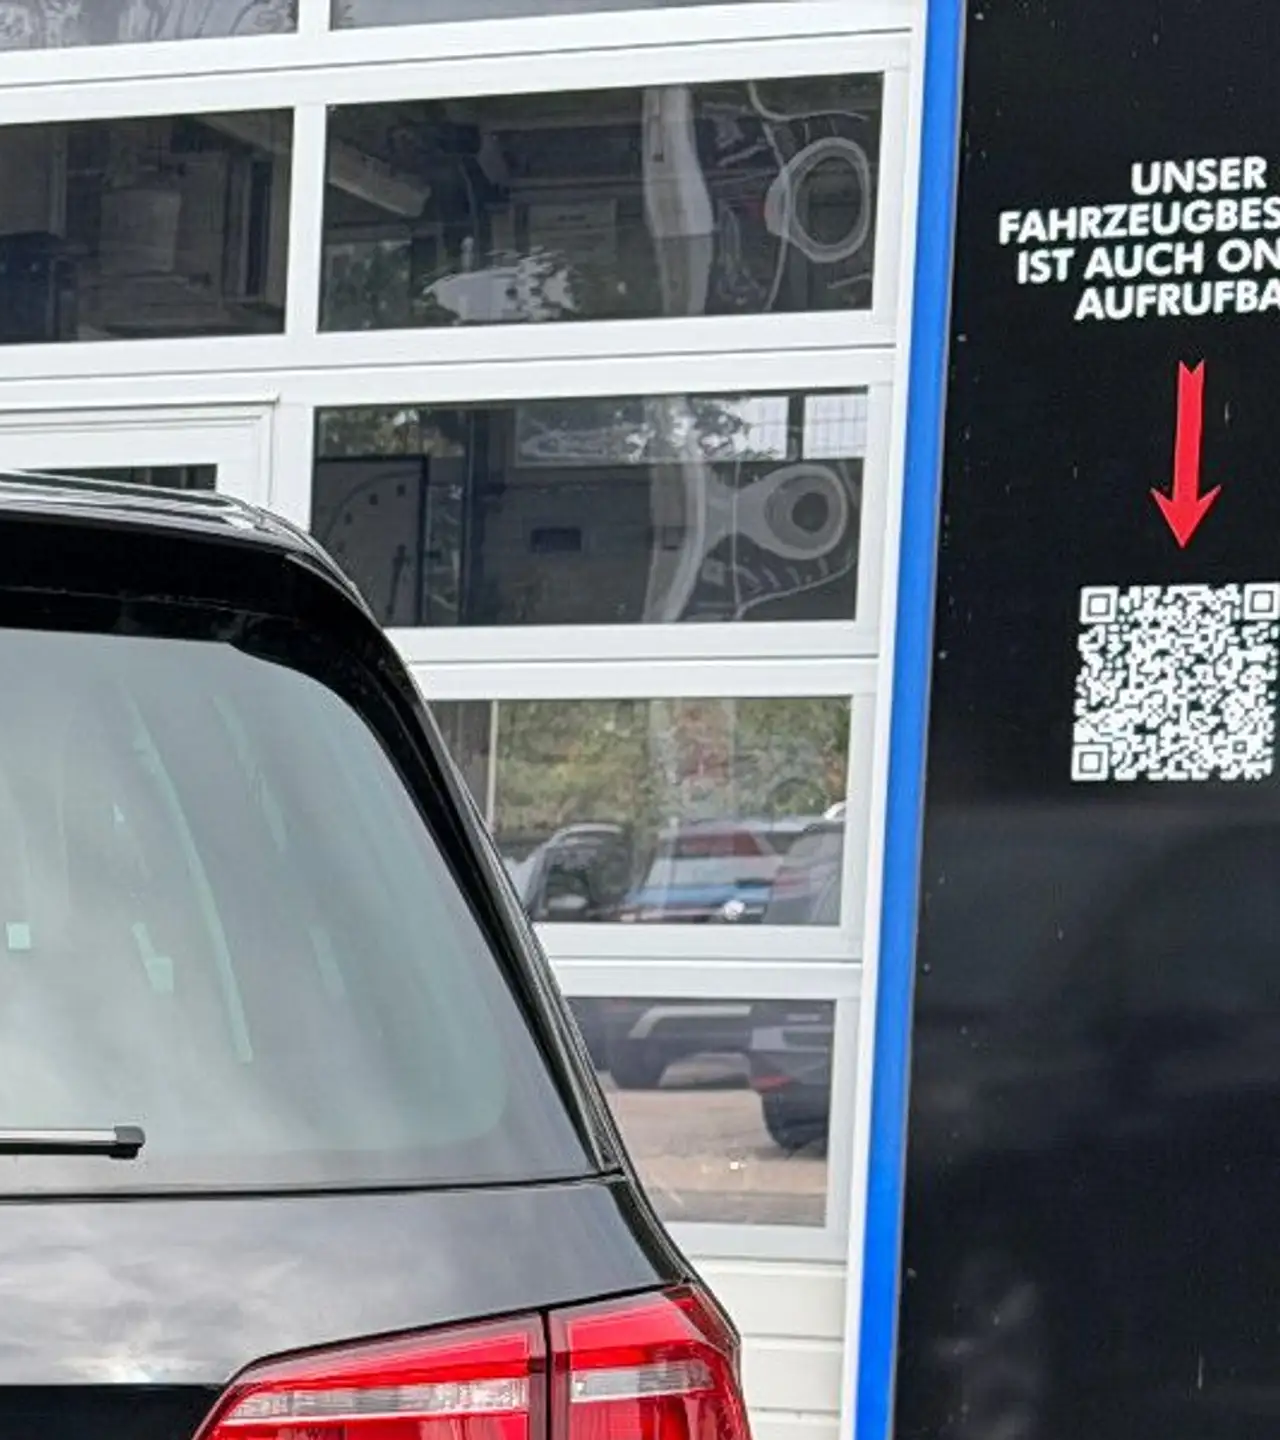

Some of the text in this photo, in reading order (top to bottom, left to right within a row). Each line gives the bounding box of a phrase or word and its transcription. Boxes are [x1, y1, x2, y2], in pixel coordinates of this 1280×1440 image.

[1130, 156, 1267, 196] UNSER
[999, 197, 1280, 245] FAHRZEUGBES
[1017, 237, 1280, 284] IST AUCH ON
